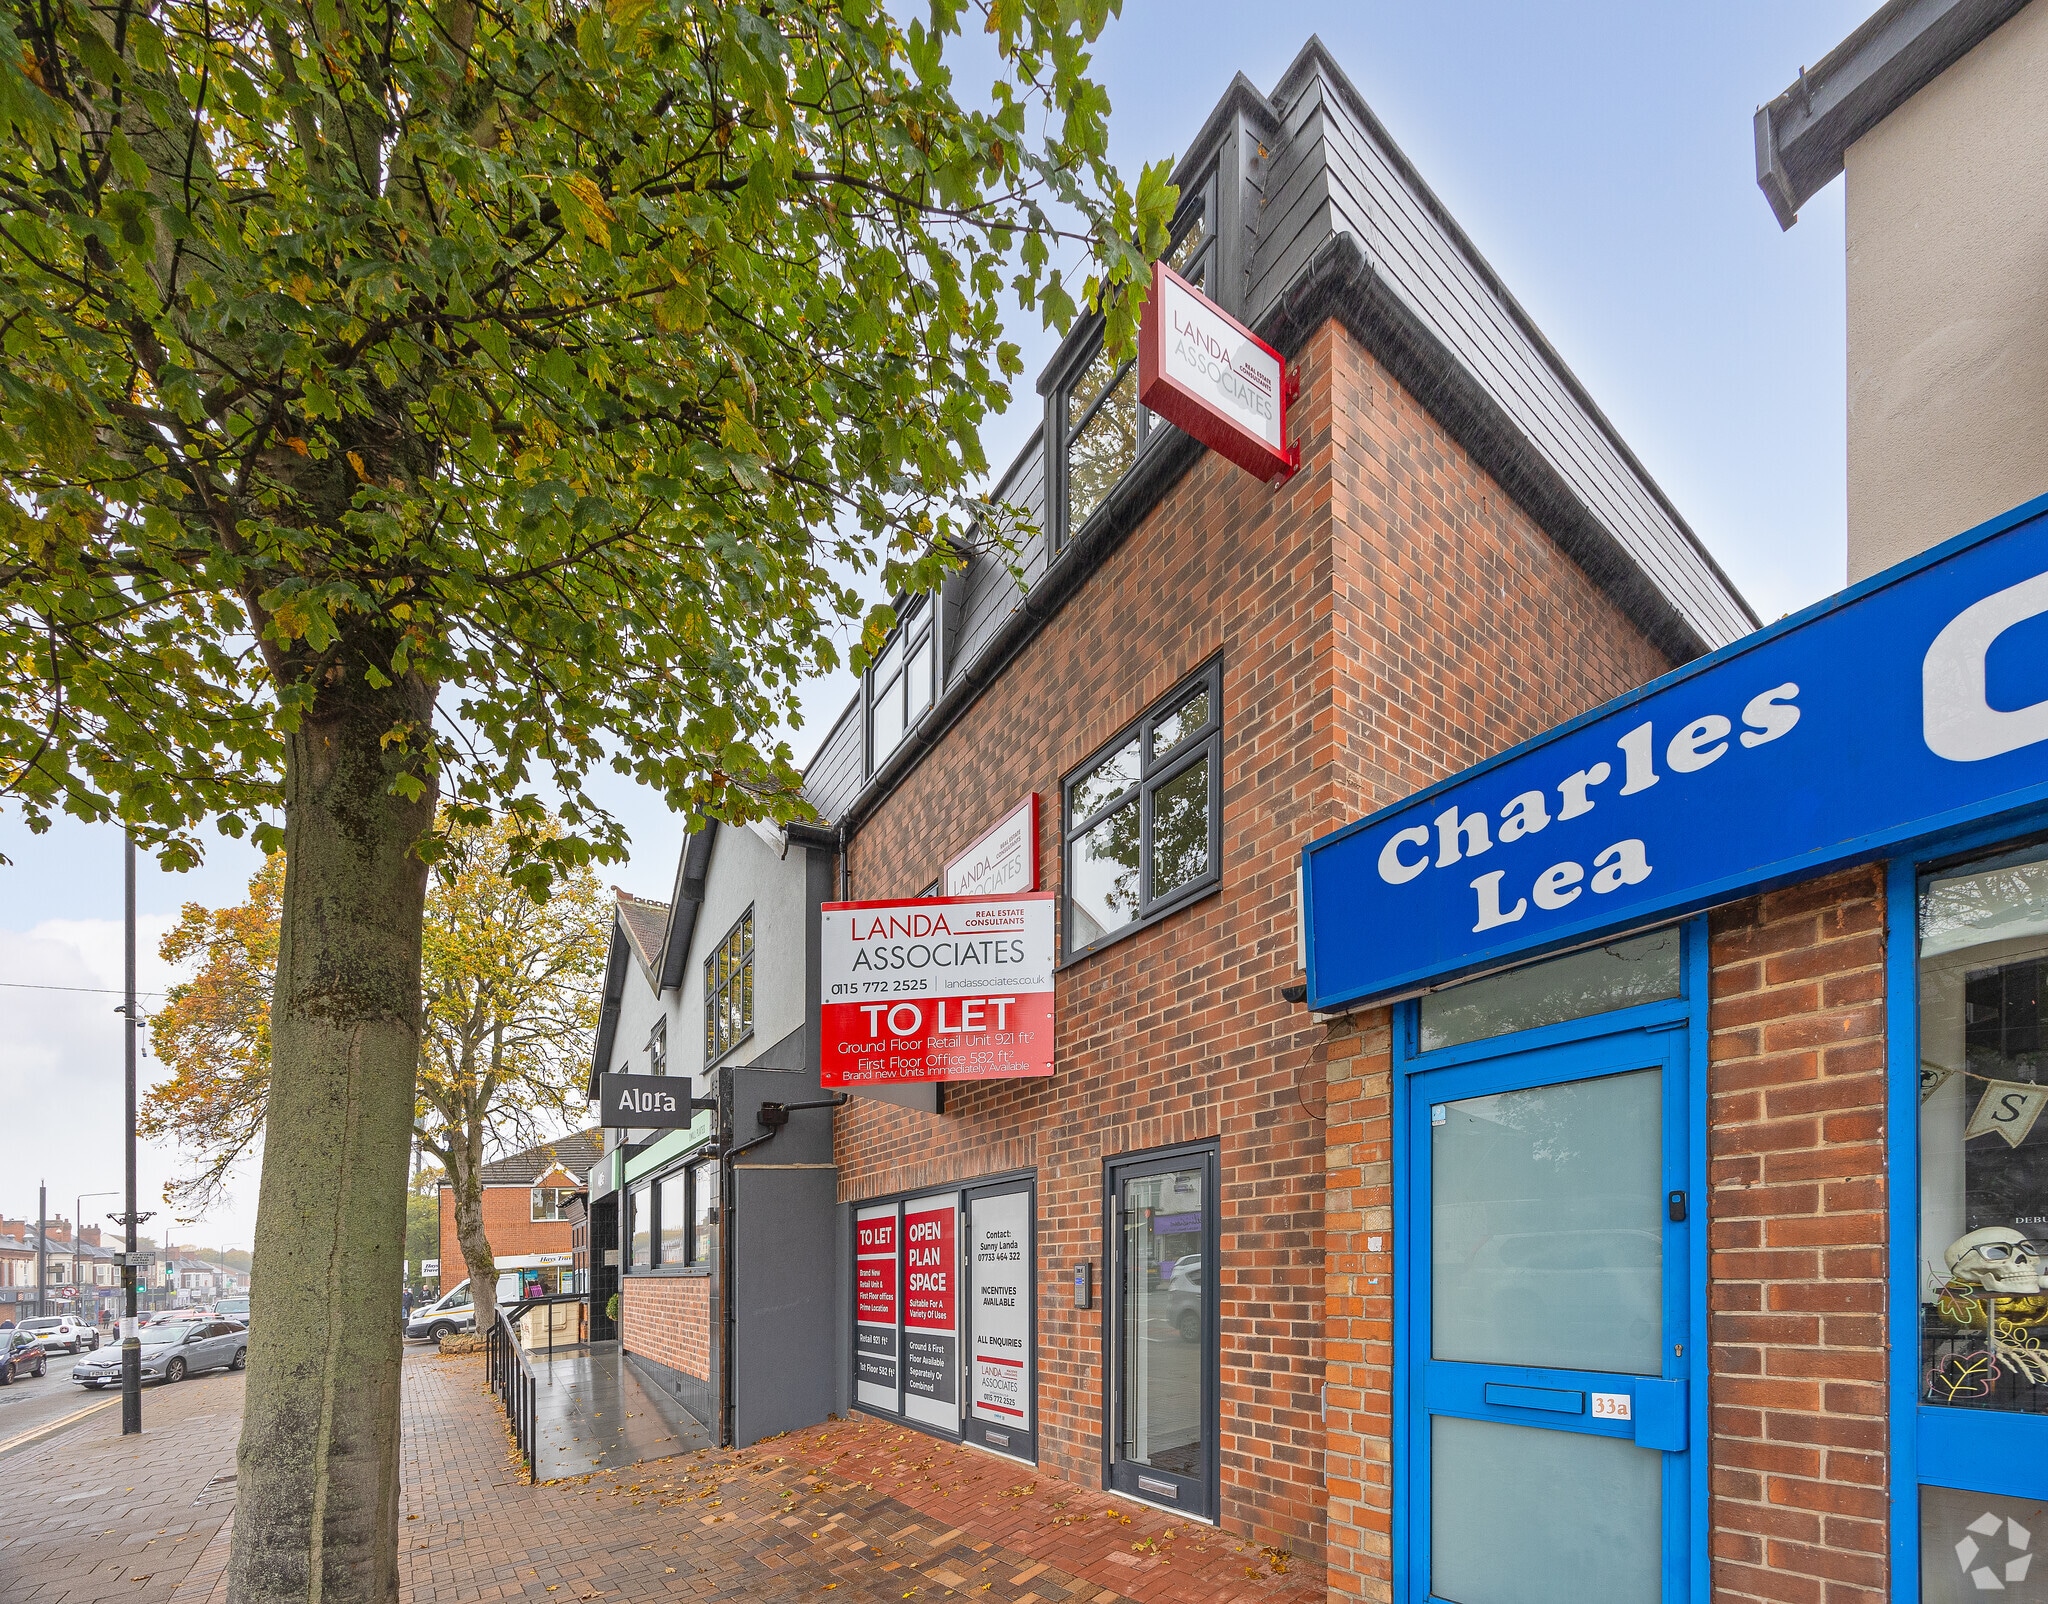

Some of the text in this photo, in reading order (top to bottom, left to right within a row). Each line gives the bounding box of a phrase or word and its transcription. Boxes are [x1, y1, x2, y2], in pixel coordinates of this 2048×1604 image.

[1174, 309, 1232, 370] LANDA
[1174, 338, 1273, 421] ASSOCIATES
[1239, 365, 1272, 392] CONSULTANTS
[1377, 682, 1801, 885] Charles
[953, 856, 992, 896] LANDA
[968, 854, 1022, 896] OCIATES
[1469, 838, 1653, 933] Lea
[975, 909, 1025, 918] REAL ESTATE
[851, 912, 952, 941] LANDA
[965, 917, 1025, 927] CONSULTANTS
[851, 939, 1025, 972] ASSOCIATES
[831, 974, 1045, 995] 0115 772 2525 landassociates.co.uk
[860, 997, 1016, 1037] TO LET
[838, 1039, 886, 1054] Ground
[890, 1038, 923, 1051] Floor
[927, 1035, 961, 1049] Retail
[965, 1034, 991, 1047] Unit
[994, 1032, 1014, 1045] 921
[858, 1057, 885, 1070] First
[889, 1055, 923, 1069] Floor
[925, 1053, 967, 1067] Office
[969, 1051, 994, 1064] 582
[842, 1061, 1030, 1081] Brand new Units Immediately Available
[618, 1088, 676, 1113] Alora
[1990, 1093, 2029, 1122] S
[860, 1227, 892, 1246] TO LET
[909, 1221, 941, 1242] OPEN
[986, 1230, 1012, 1239] Contact:
[980, 1240, 1019, 1252] Sunny Landa
[909, 1247, 940, 1267] PLAN
[978, 1252, 1021, 1262] 07733 464 322
[860, 1269, 881, 1277] Brand New
[871, 1281, 880, 1289] Unit
[909, 1273, 947, 1291] SPACE
[860, 1292, 894, 1300] First Floor offices
[981, 1286, 1017, 1295] INCENTIVES
[860, 1303, 889, 1313] Prime Location
[909, 1299, 943, 1308] Suitable For A
[983, 1297, 1015, 1307] AVAILABLE
[909, 1309, 947, 1320] Variety Of Uses
[860, 1333, 872, 1344] Retail
[977, 1335, 1022, 1348] ALL ENQUIRIES
[909, 1341, 945, 1354] Ground & First
[909, 1354, 945, 1367] Floor Available
[866, 1364, 879, 1374] Floor
[878, 1366, 888, 1376] 582
[909, 1367, 943, 1380] Separately Or
[981, 1365, 1002, 1377] LANDA
[909, 1380, 934, 1392] Combined
[982, 1378, 1018, 1393] ASSOCIATES
[1595, 1397, 1628, 1416] 33a
